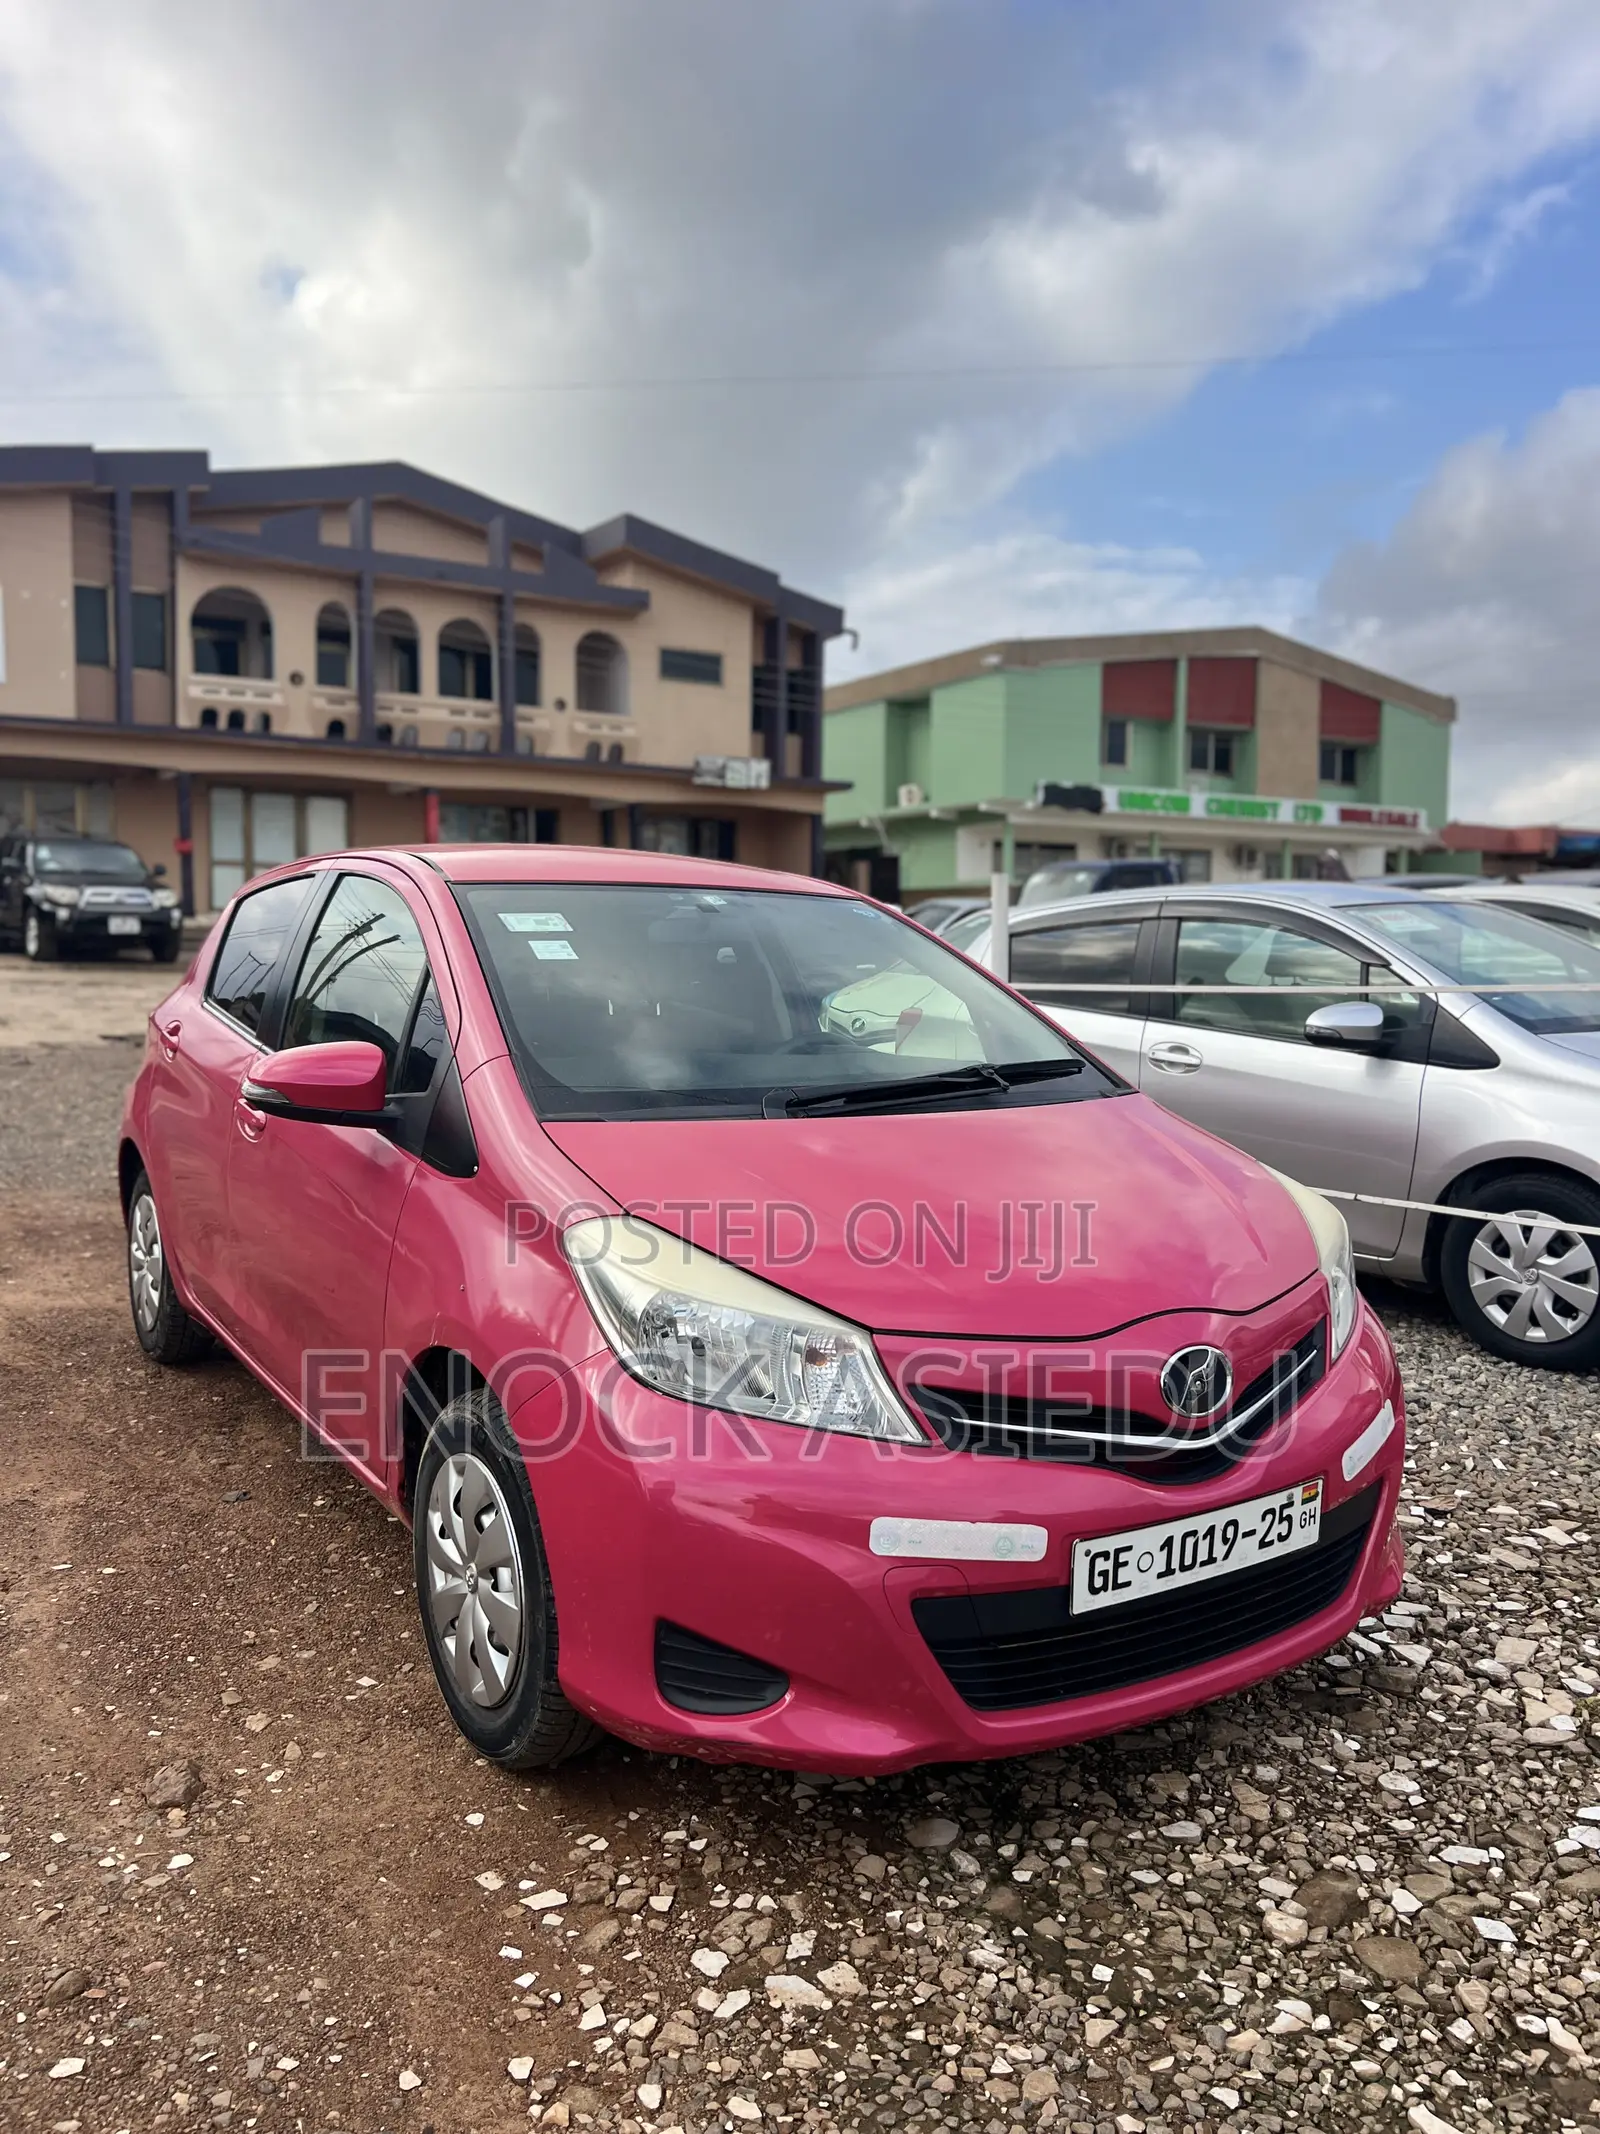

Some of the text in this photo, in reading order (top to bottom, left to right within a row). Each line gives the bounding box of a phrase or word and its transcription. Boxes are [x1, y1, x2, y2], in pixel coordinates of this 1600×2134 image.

[1299, 1506, 1317, 1530] GH
[1087, 1501, 1295, 1596] GE 1019-25
